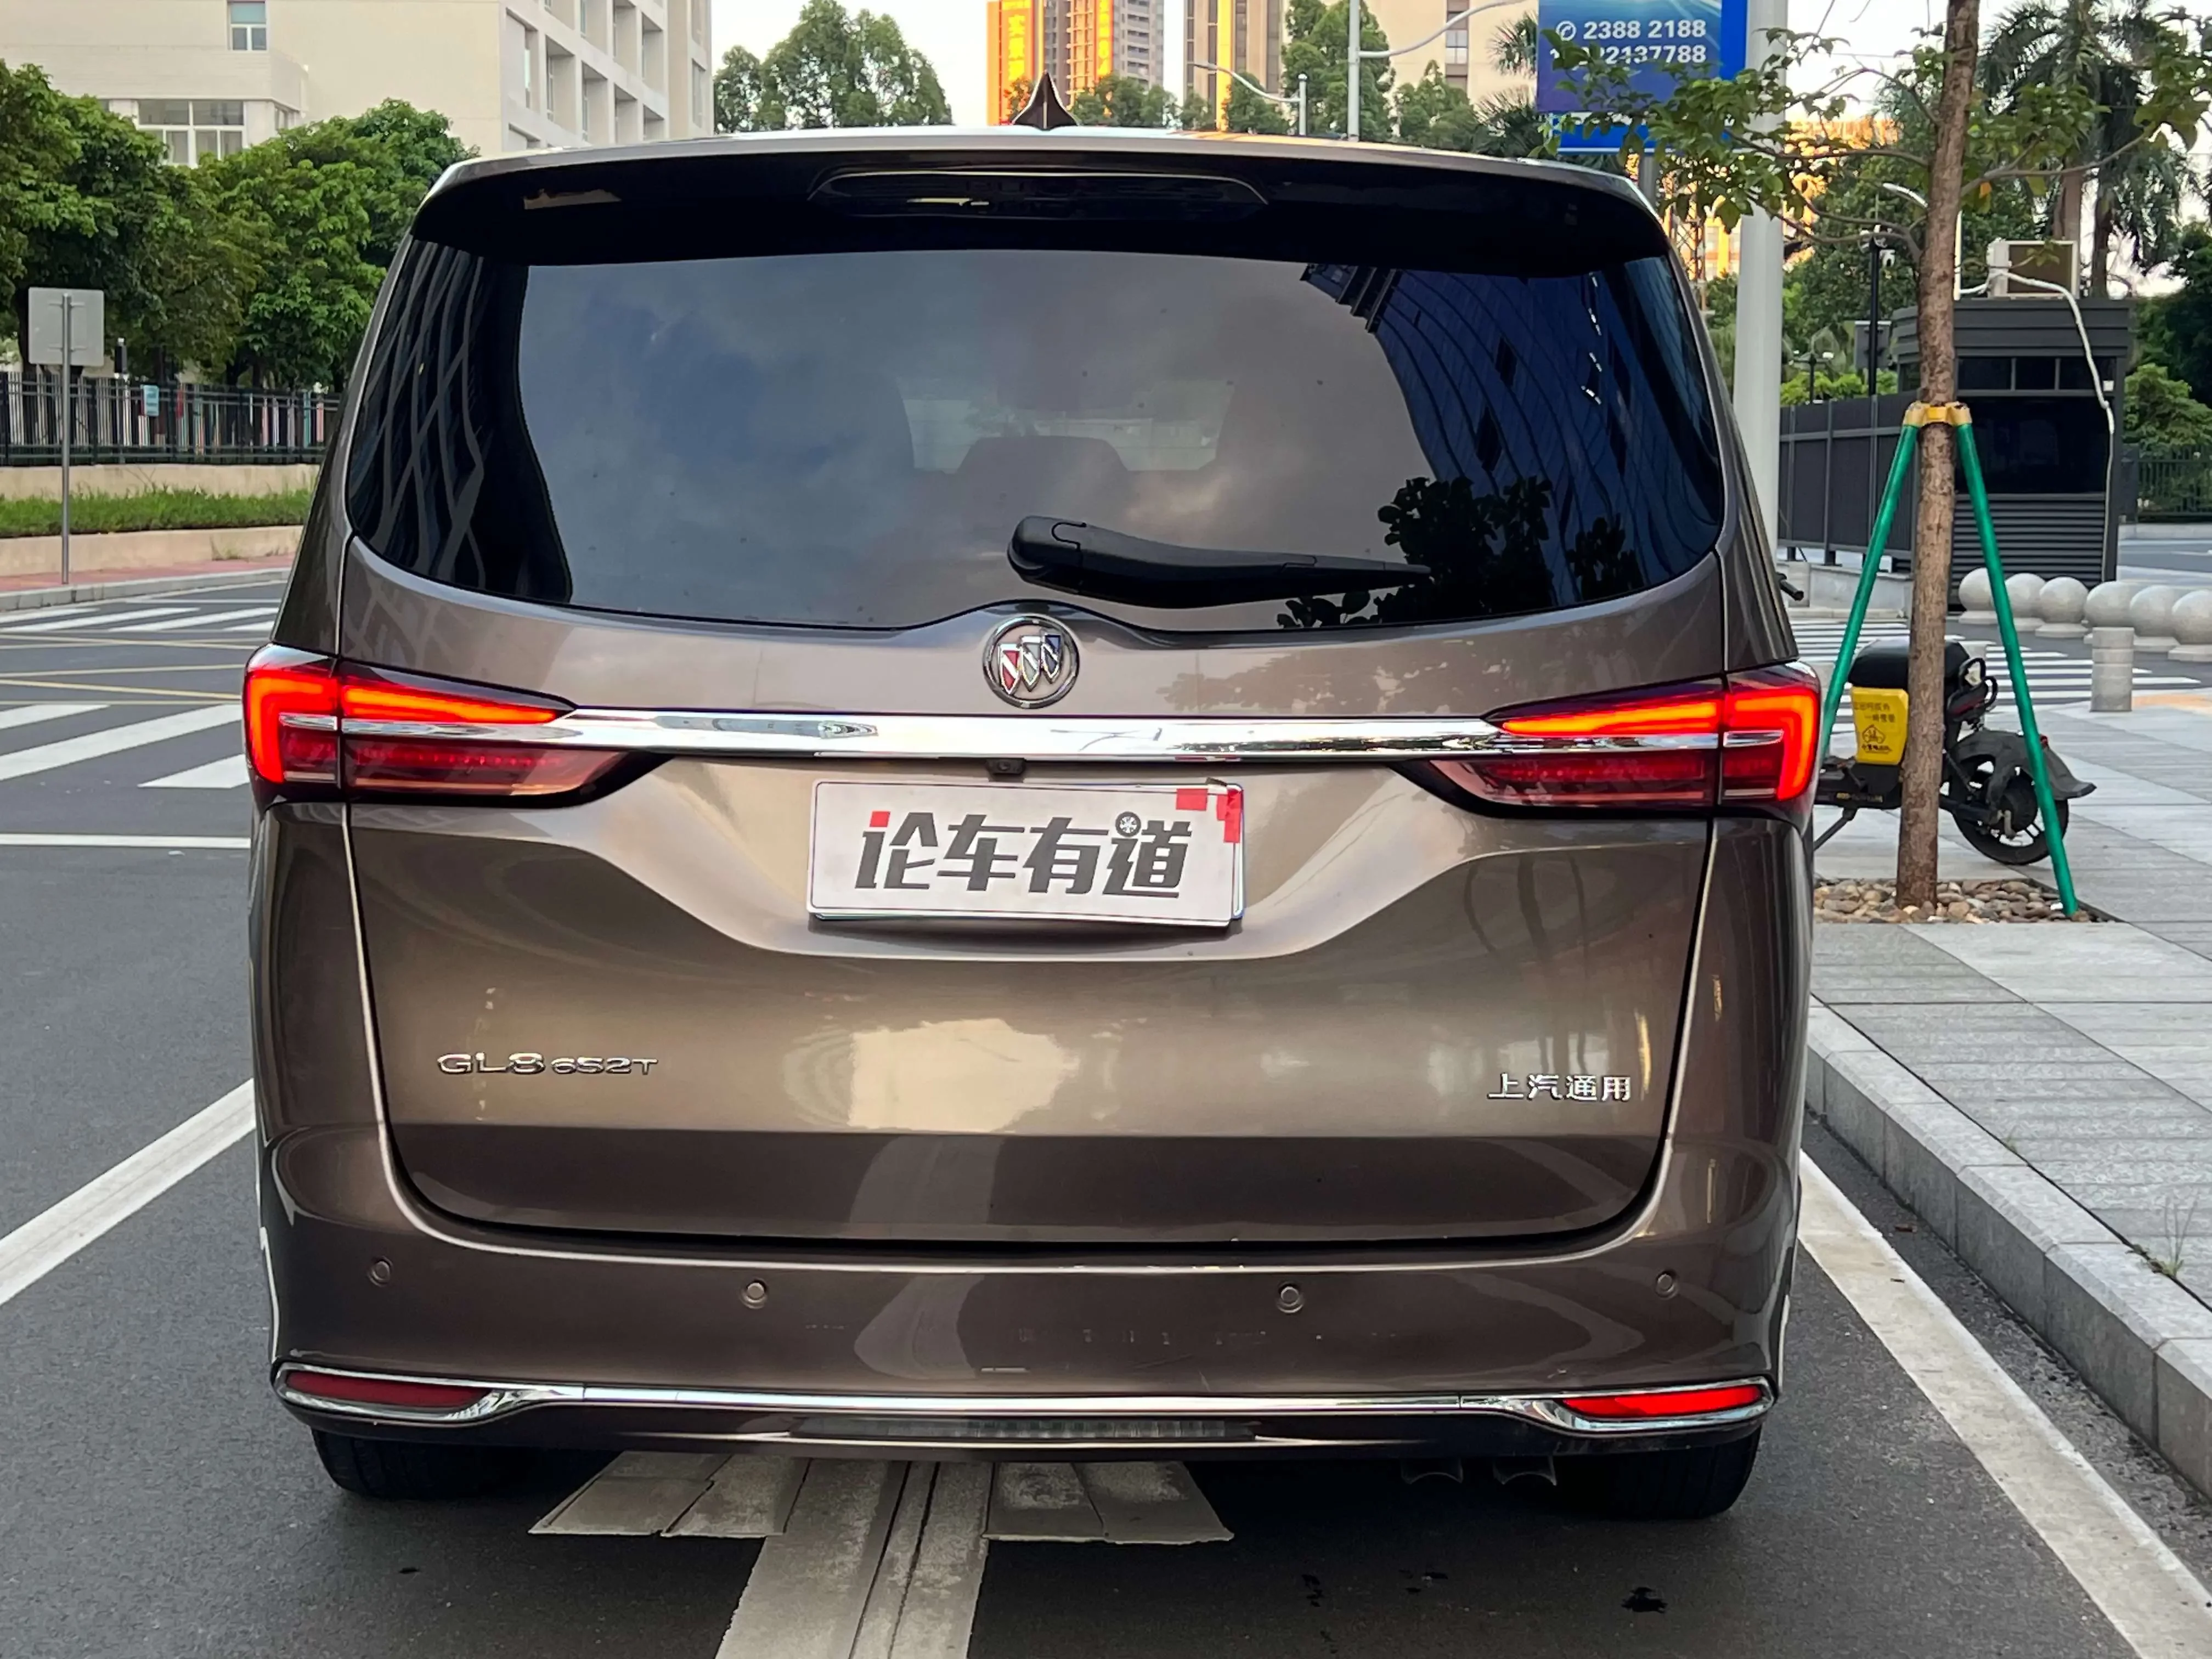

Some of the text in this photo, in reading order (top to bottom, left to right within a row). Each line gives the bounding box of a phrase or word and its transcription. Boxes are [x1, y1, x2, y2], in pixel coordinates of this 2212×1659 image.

[1583, 20, 1706, 40] 2388 2188
[855, 811, 1192, 899] 论车有道
[437, 1052, 659, 1075] GL8 652T
[1486, 1073, 1632, 1102] 上汽通用
